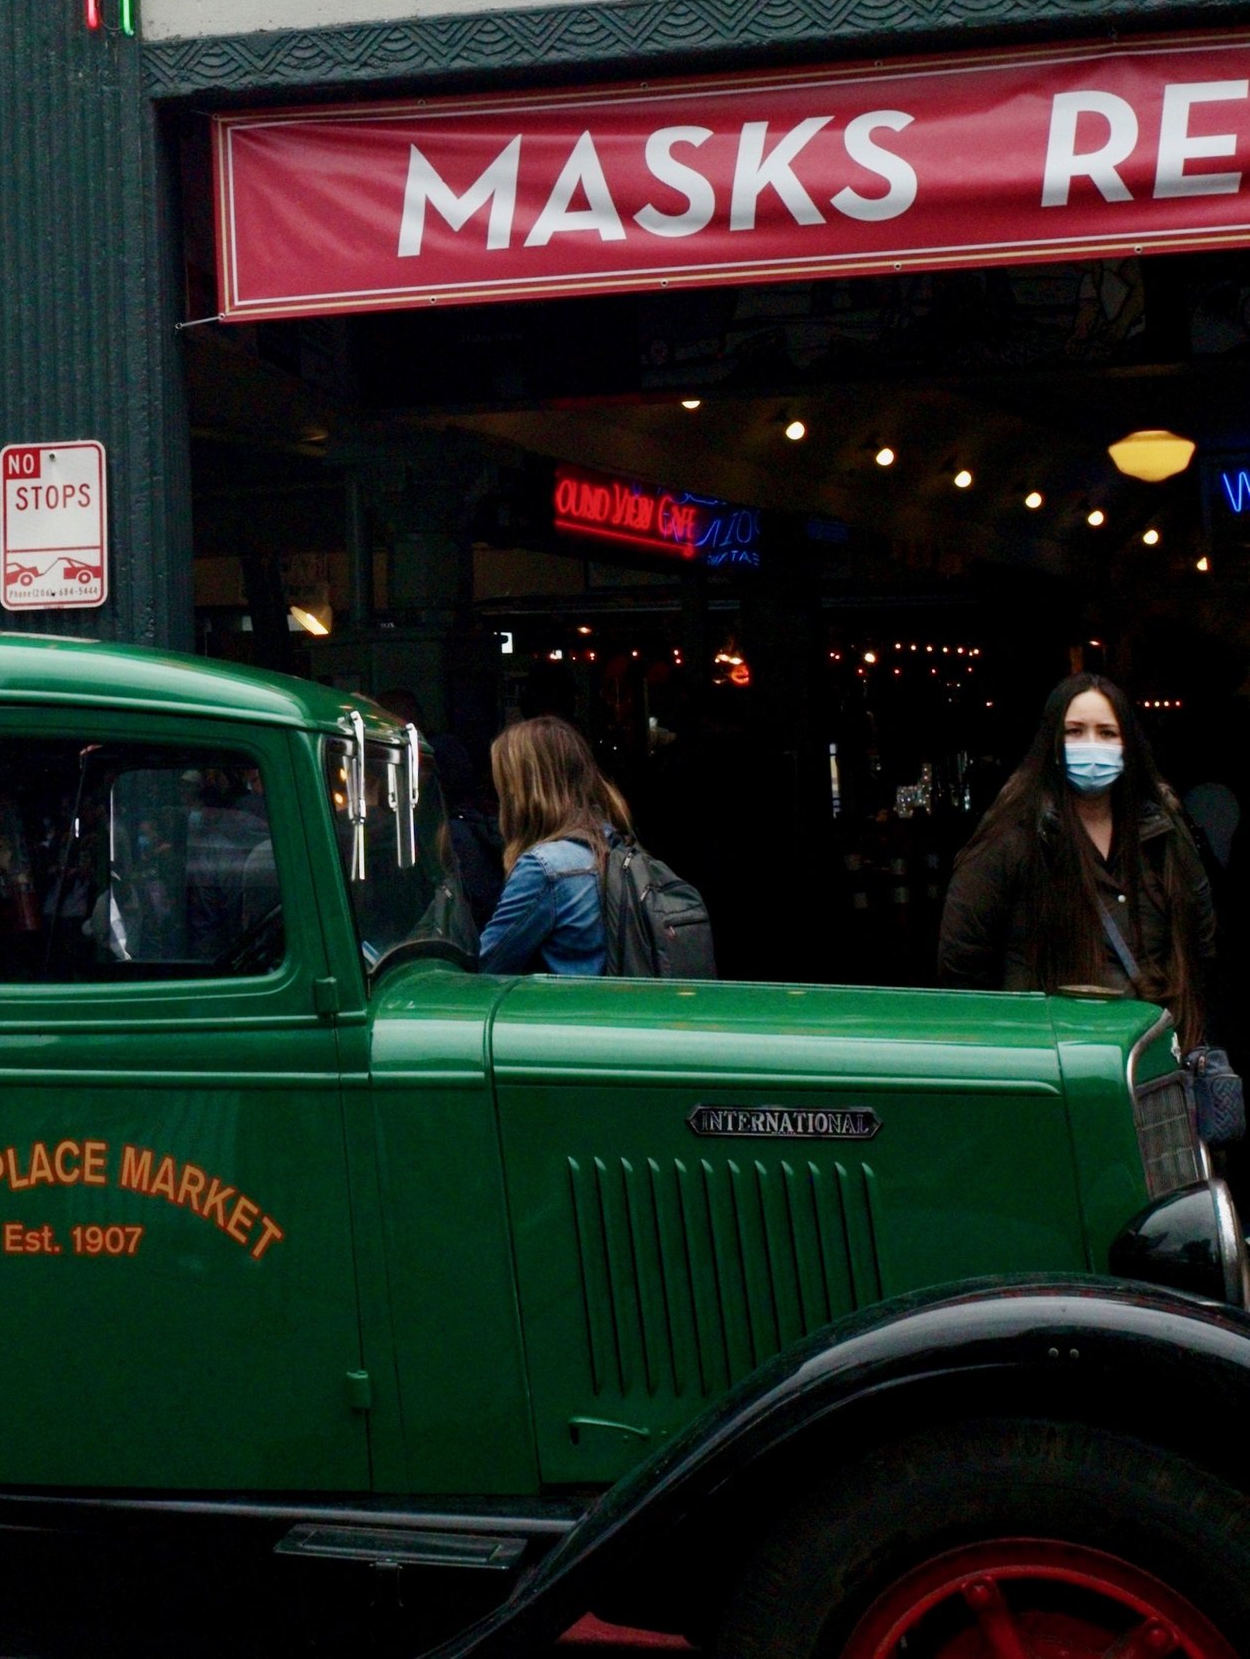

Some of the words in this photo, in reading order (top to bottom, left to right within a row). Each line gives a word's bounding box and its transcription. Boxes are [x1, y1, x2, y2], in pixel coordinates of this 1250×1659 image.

[397, 109, 918, 258] MASKS
[1040, 78, 1250, 208] RE
[8, 453, 35, 475] NO
[15, 483, 91, 511] STOPS
[9, 589, 32, 599] Phone
[701, 1110, 870, 1135] INTERNATIONAL
[119, 1145, 285, 1261] MARKET
[3, 1223, 61, 1255] Est.
[72, 1225, 144, 1256] 1907
